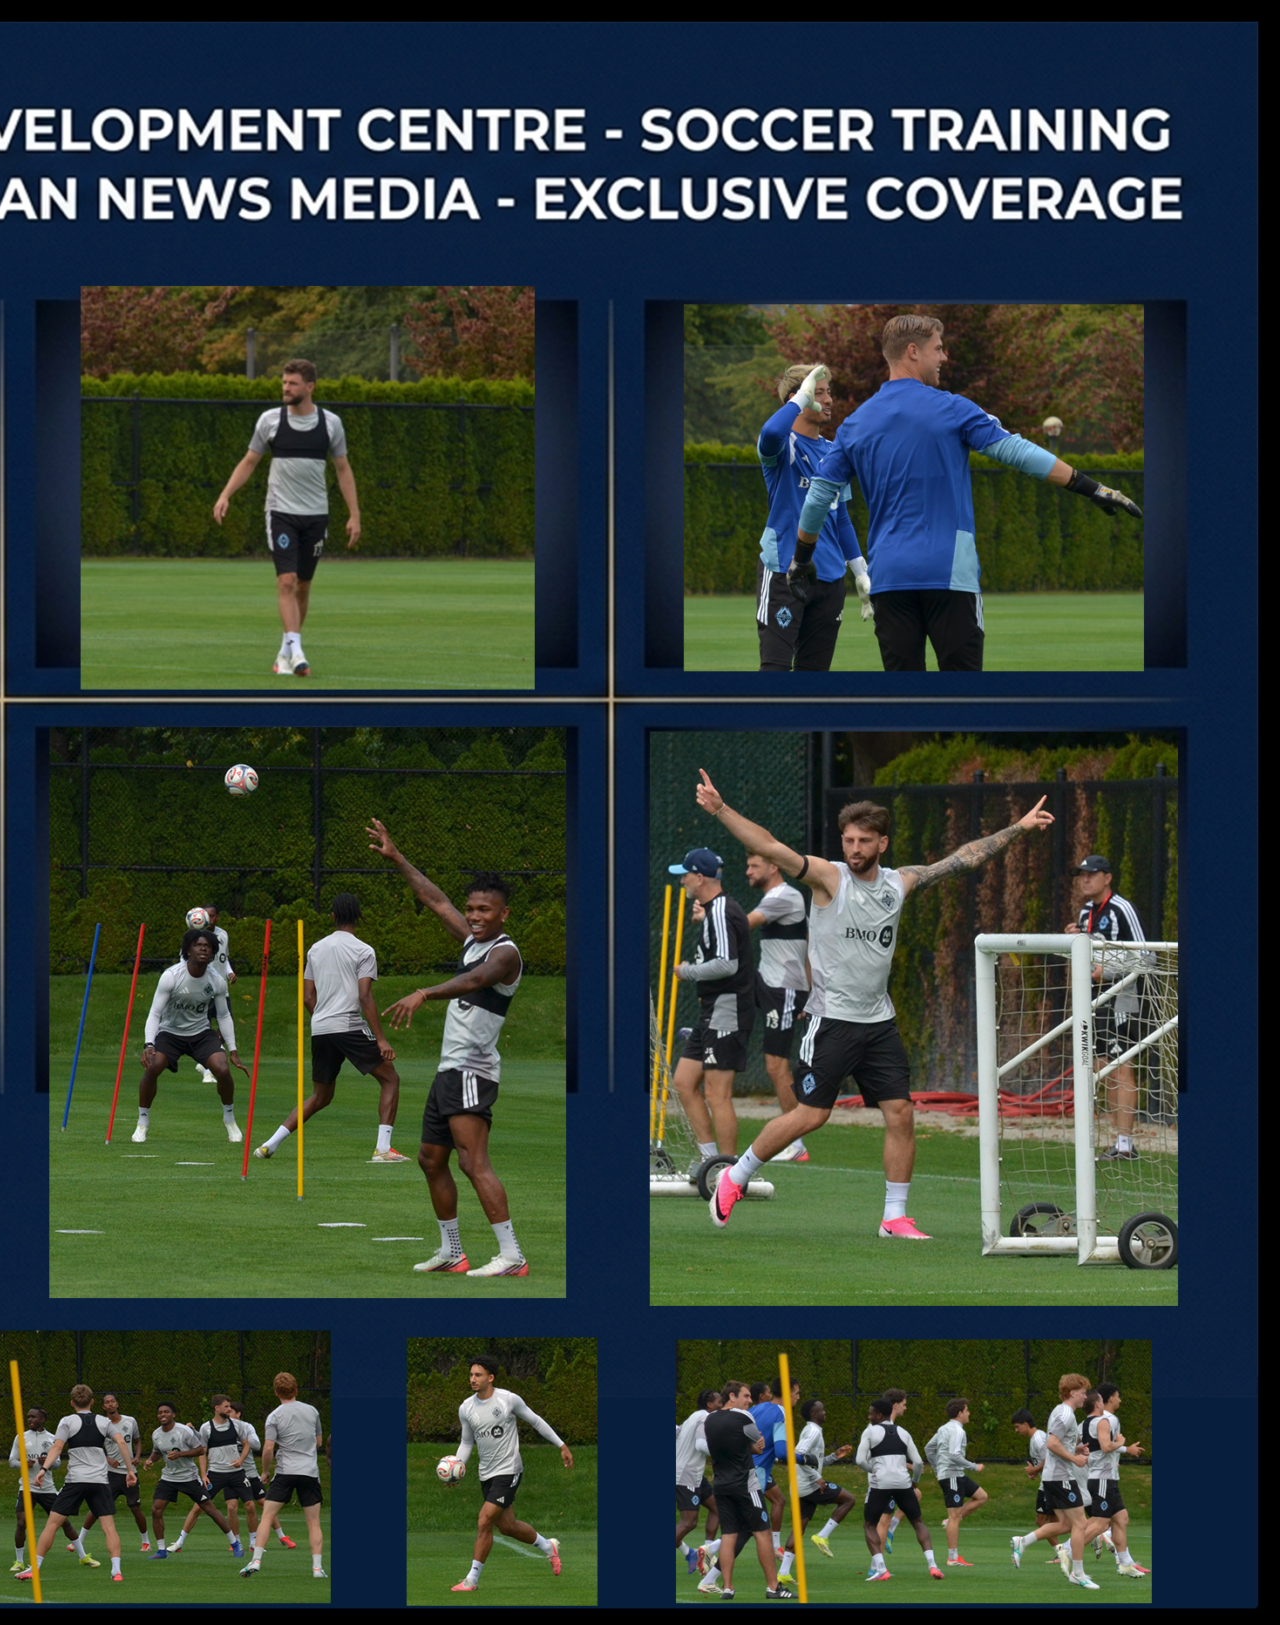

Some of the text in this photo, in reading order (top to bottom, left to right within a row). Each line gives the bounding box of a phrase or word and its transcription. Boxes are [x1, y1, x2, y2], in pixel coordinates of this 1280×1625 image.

[845, 926, 877, 943] BMO
[766, 1016, 779, 1030] 13
[704, 1047, 714, 1055] JS
